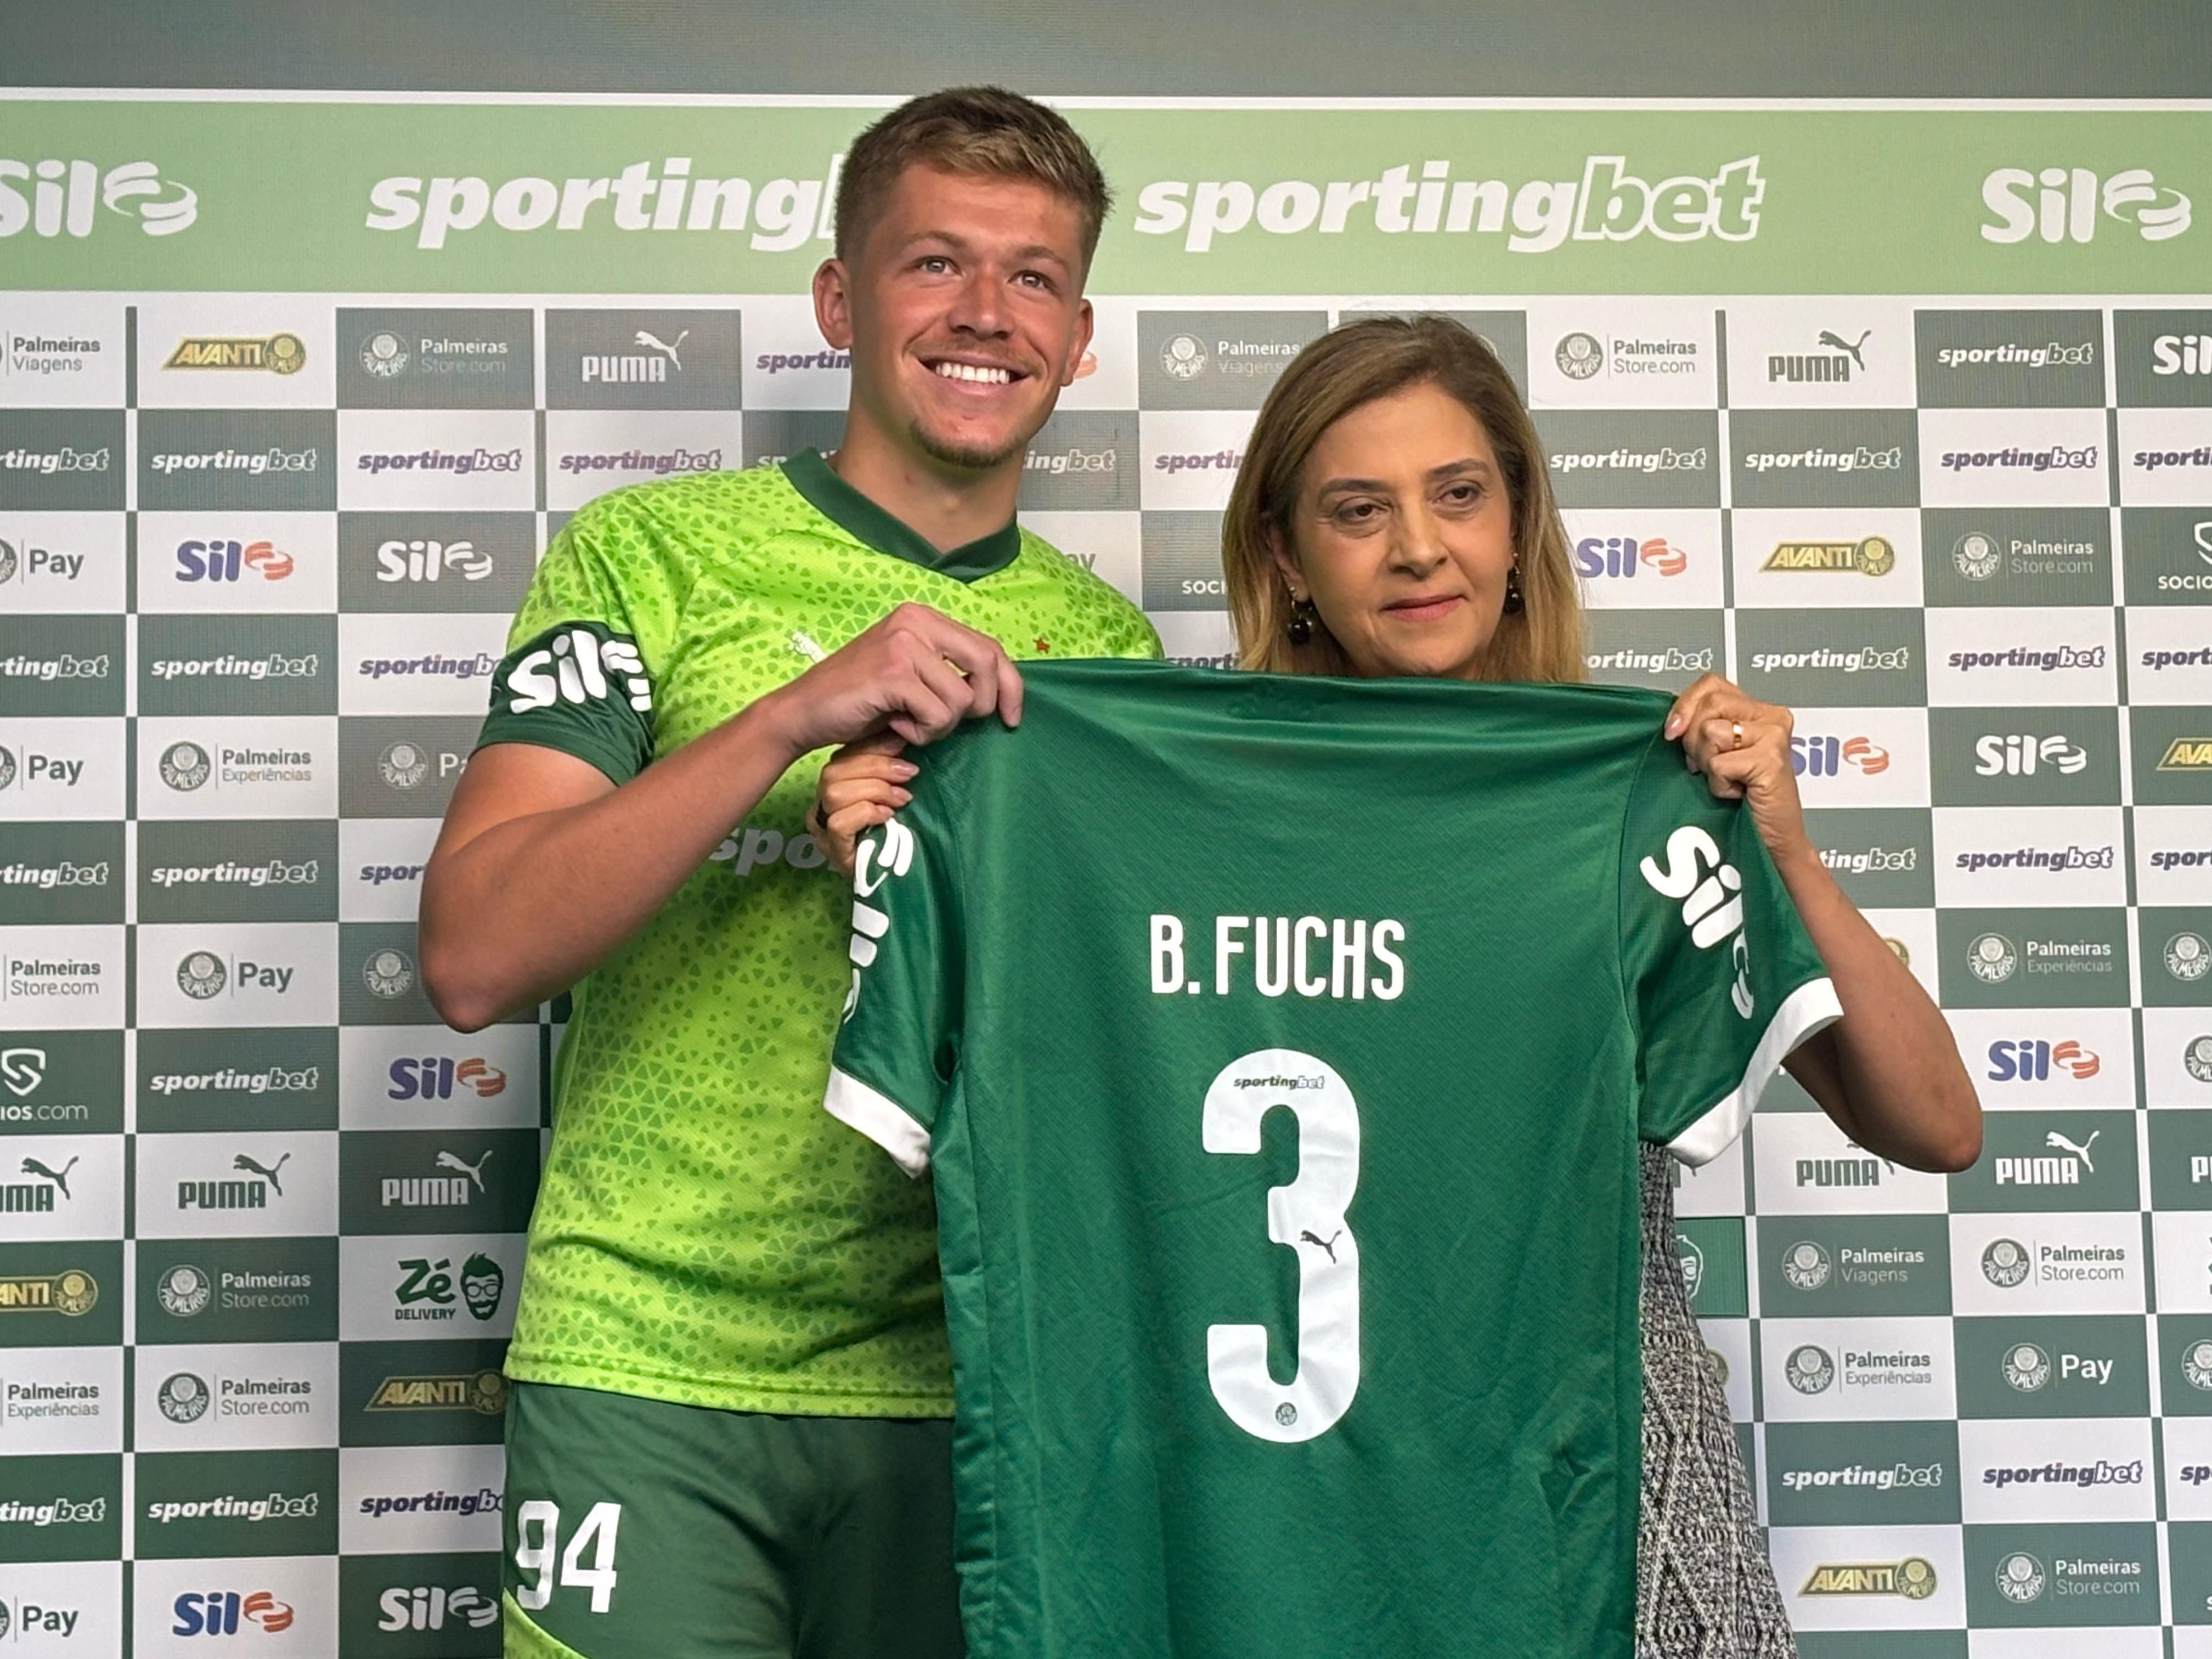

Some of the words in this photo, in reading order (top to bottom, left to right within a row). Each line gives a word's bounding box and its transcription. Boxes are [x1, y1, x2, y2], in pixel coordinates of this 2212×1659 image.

[365, 154, 844, 251] sporting
[1135, 156, 1766, 253] sportingbet
[1982, 169, 2097, 244] Sil
[15, 337, 100, 352] Palmeiras
[176, 343, 261, 365] AVANTI
[422, 339, 508, 354] Palmeiras
[1218, 340, 1299, 357] Palmeiras
[1615, 340, 1697, 355] Palmeiras
[1939, 343, 2094, 368] sportingbet
[2154, 336, 2212, 375] Sil
[13, 357, 82, 375] Viagens
[422, 357, 506, 374] Store.com
[583, 357, 665, 382] PUMA
[1615, 359, 1696, 374] Store.com
[1769, 357, 1850, 382] PUMA
[153, 449, 317, 475] sportingbet
[359, 449, 522, 475] sportingbet
[560, 449, 721, 474] sportingbet
[1551, 449, 1706, 473] sportingbet
[1746, 448, 1901, 472] sportingbet
[1942, 447, 2098, 472] sportingbet
[2135, 448, 2212, 471] sporti
[1577, 538, 1637, 578] Sil
[1773, 547, 1852, 567] AVANTI
[2012, 540, 2094, 555] Palmeiras
[30, 550, 84, 580] Pay
[177, 541, 242, 582] Sil
[377, 541, 442, 582] Sil
[2012, 558, 2094, 574] Store.com
[0, 656, 109, 680] tingbet
[153, 655, 318, 680] sportingbet
[507, 630, 606, 713] Sil
[1588, 648, 1713, 673] ortingbet
[1752, 648, 1909, 673] sportingbet
[1949, 646, 2106, 672] sportingbet
[223, 749, 312, 765] Palmeiras
[1976, 736, 2038, 776] Sil
[30, 756, 84, 786] Pay
[223, 769, 312, 785] Experiências
[1957, 847, 2114, 872] sportingbet
[2151, 853, 2212, 871] spor
[0, 863, 109, 889] tingbet
[152, 861, 318, 888] sportingbet
[1150, 914, 1200, 994] B.
[1216, 916, 1406, 1000] FUCHS
[2028, 941, 2111, 956] Palmeiras
[12, 960, 101, 976] Palmeiras
[240, 963, 294, 994] Pay
[2028, 960, 2113, 975] Experiências
[12, 980, 99, 996] Store.com
[1989, 1041, 2050, 1082] Sil
[151, 1068, 319, 1095] sportingbet
[389, 1058, 455, 1101] Sil
[1233, 1075, 1324, 1090] sportingbet
[1797, 1160, 1880, 1187] PUMA
[1996, 1158, 2079, 1184] PUMA
[0, 1185, 54, 1212] MA
[179, 1182, 266, 1210] PUMA
[383, 1179, 469, 1206] PUMA
[1202, 1048, 1360, 1443] 3
[1842, 1249, 1925, 1263] Palmeiras
[2042, 1246, 2125, 1262] Palmeiras
[223, 1272, 311, 1288] Palmeiras
[396, 1259, 457, 1305] Zé
[1842, 1269, 1908, 1285] Viagens
[2042, 1266, 2124, 1281] Store.com
[222, 1293, 309, 1308] Store.com
[396, 1308, 457, 1321] DELIVERY
[1846, 1351, 1931, 1368] Palmeiras
[2062, 1355, 2113, 1385] Pay
[223, 1379, 312, 1395] Palmeiras
[1846, 1367, 1932, 1387] Experiências
[9, 1383, 99, 1400] Palmeiras
[378, 1381, 465, 1403] AVANTI
[9, 1399, 100, 1420] Experiências
[222, 1400, 310, 1415] Store.com
[1784, 1464, 1942, 1491] sportingbet
[1984, 1461, 2143, 1488] sportingbet
[149, 1494, 318, 1523] sportingbet
[515, 1500, 621, 1613] 94
[2057, 1559, 2141, 1575] Palmeiras
[1810, 1570, 1893, 1591] AVANTI
[2057, 1579, 2140, 1595] Store.com
[24, 1607, 78, 1638] Pay
[173, 1593, 241, 1637] Sil
[379, 1588, 445, 1632] Sil
